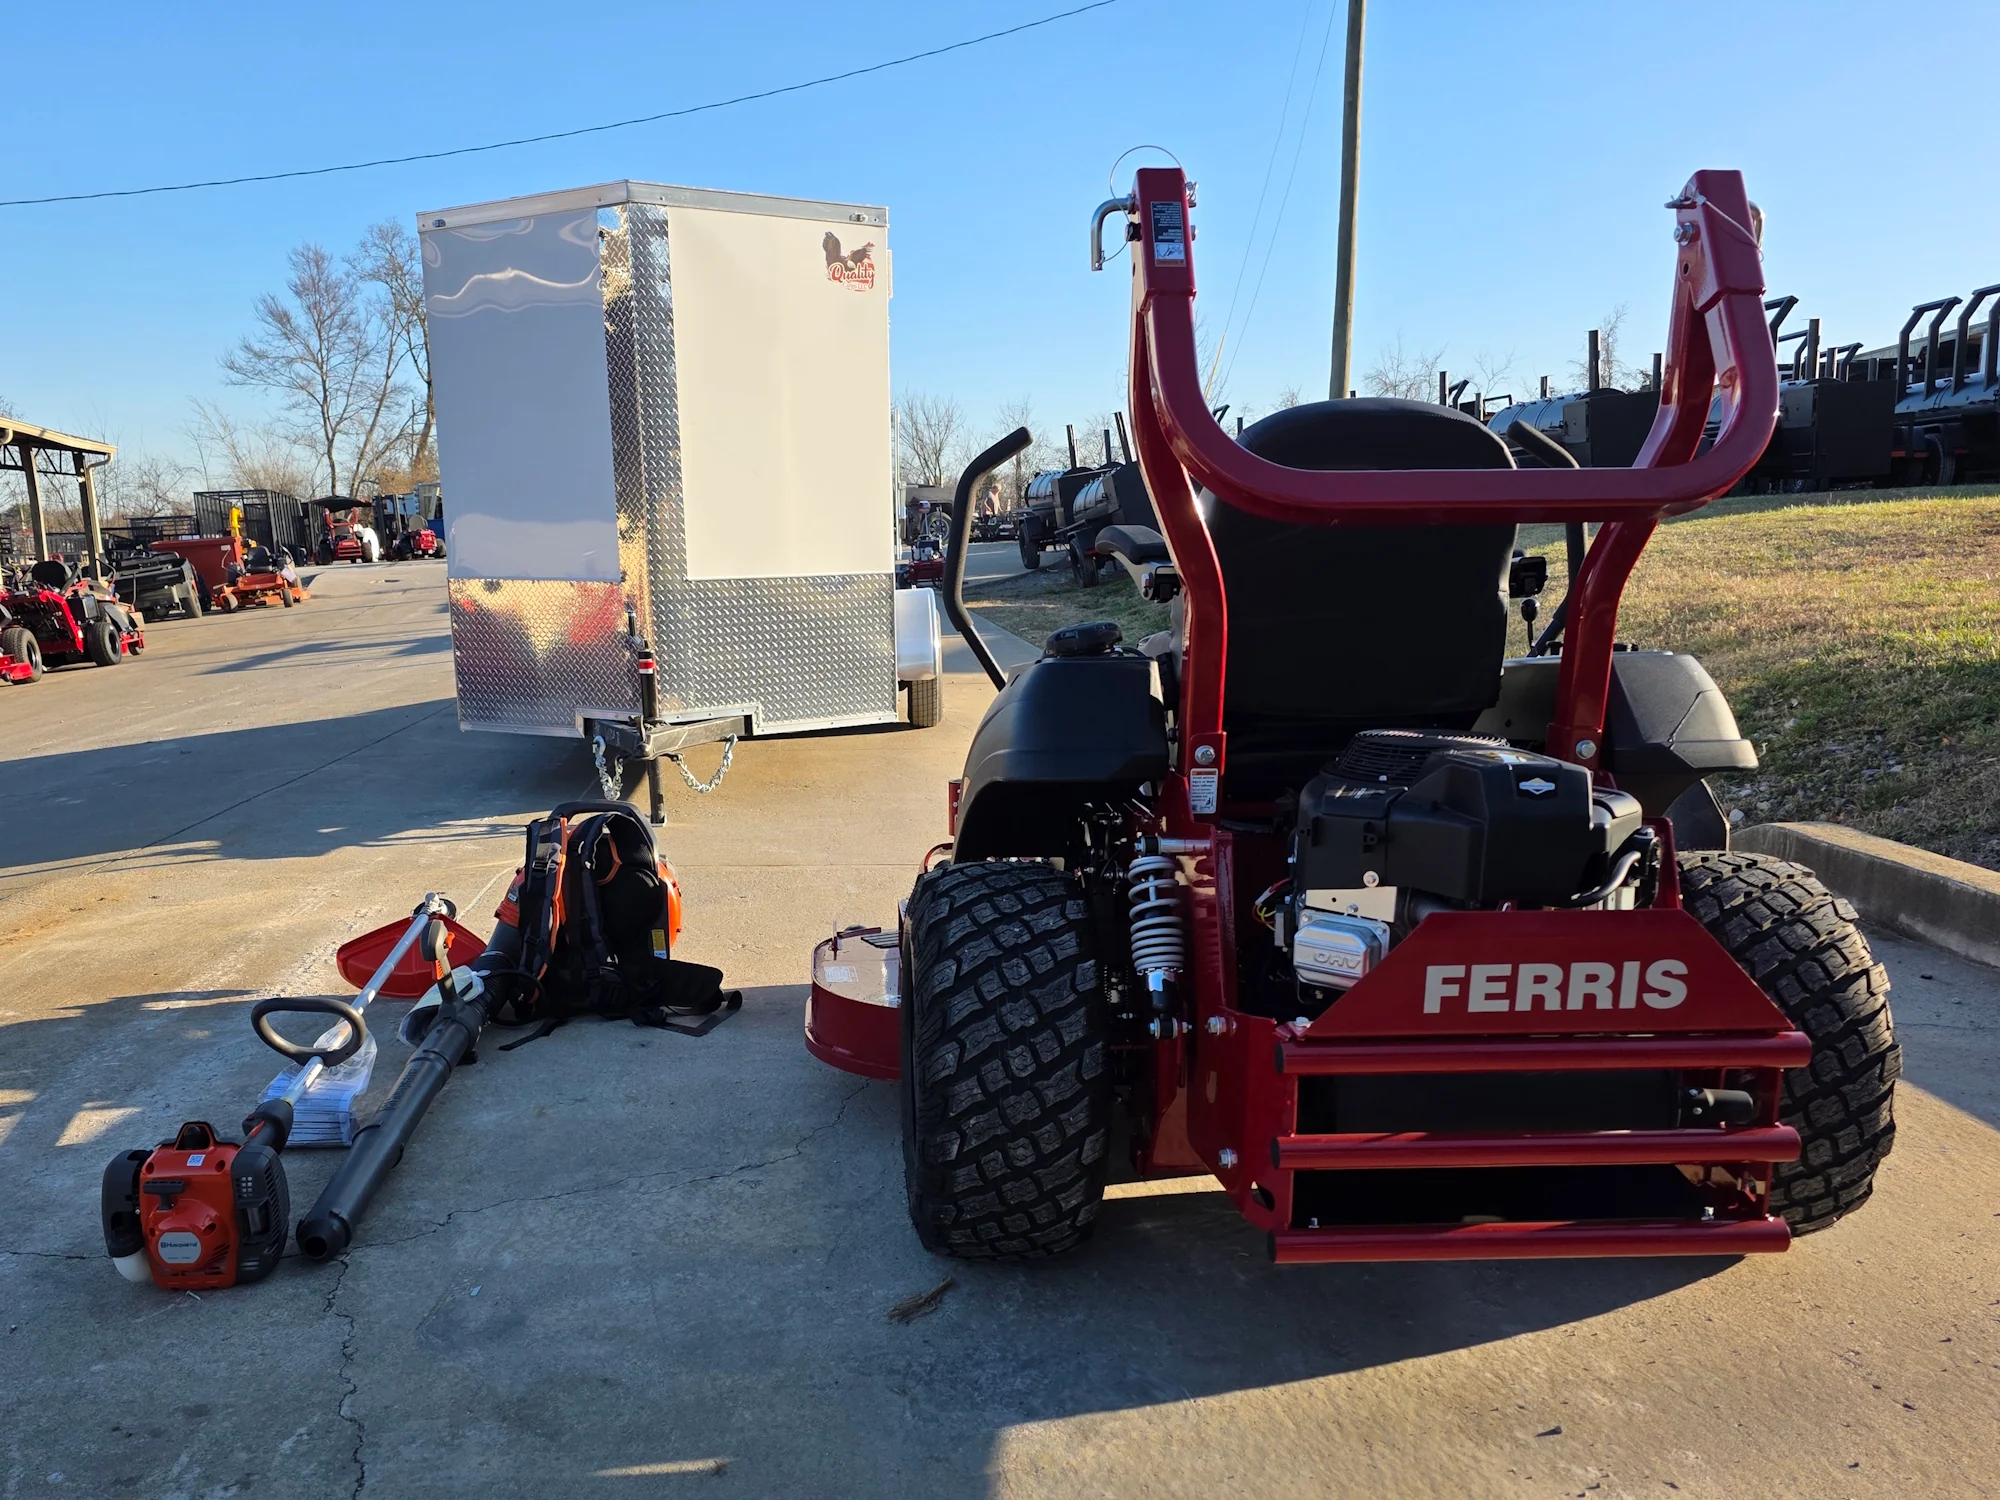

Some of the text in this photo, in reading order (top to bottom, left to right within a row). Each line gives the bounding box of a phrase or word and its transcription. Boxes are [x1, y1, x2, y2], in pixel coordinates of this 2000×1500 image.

[829, 263, 875, 289] Quality
[1313, 951, 1362, 969] OHV
[1423, 959, 1689, 1014] FERRIS
